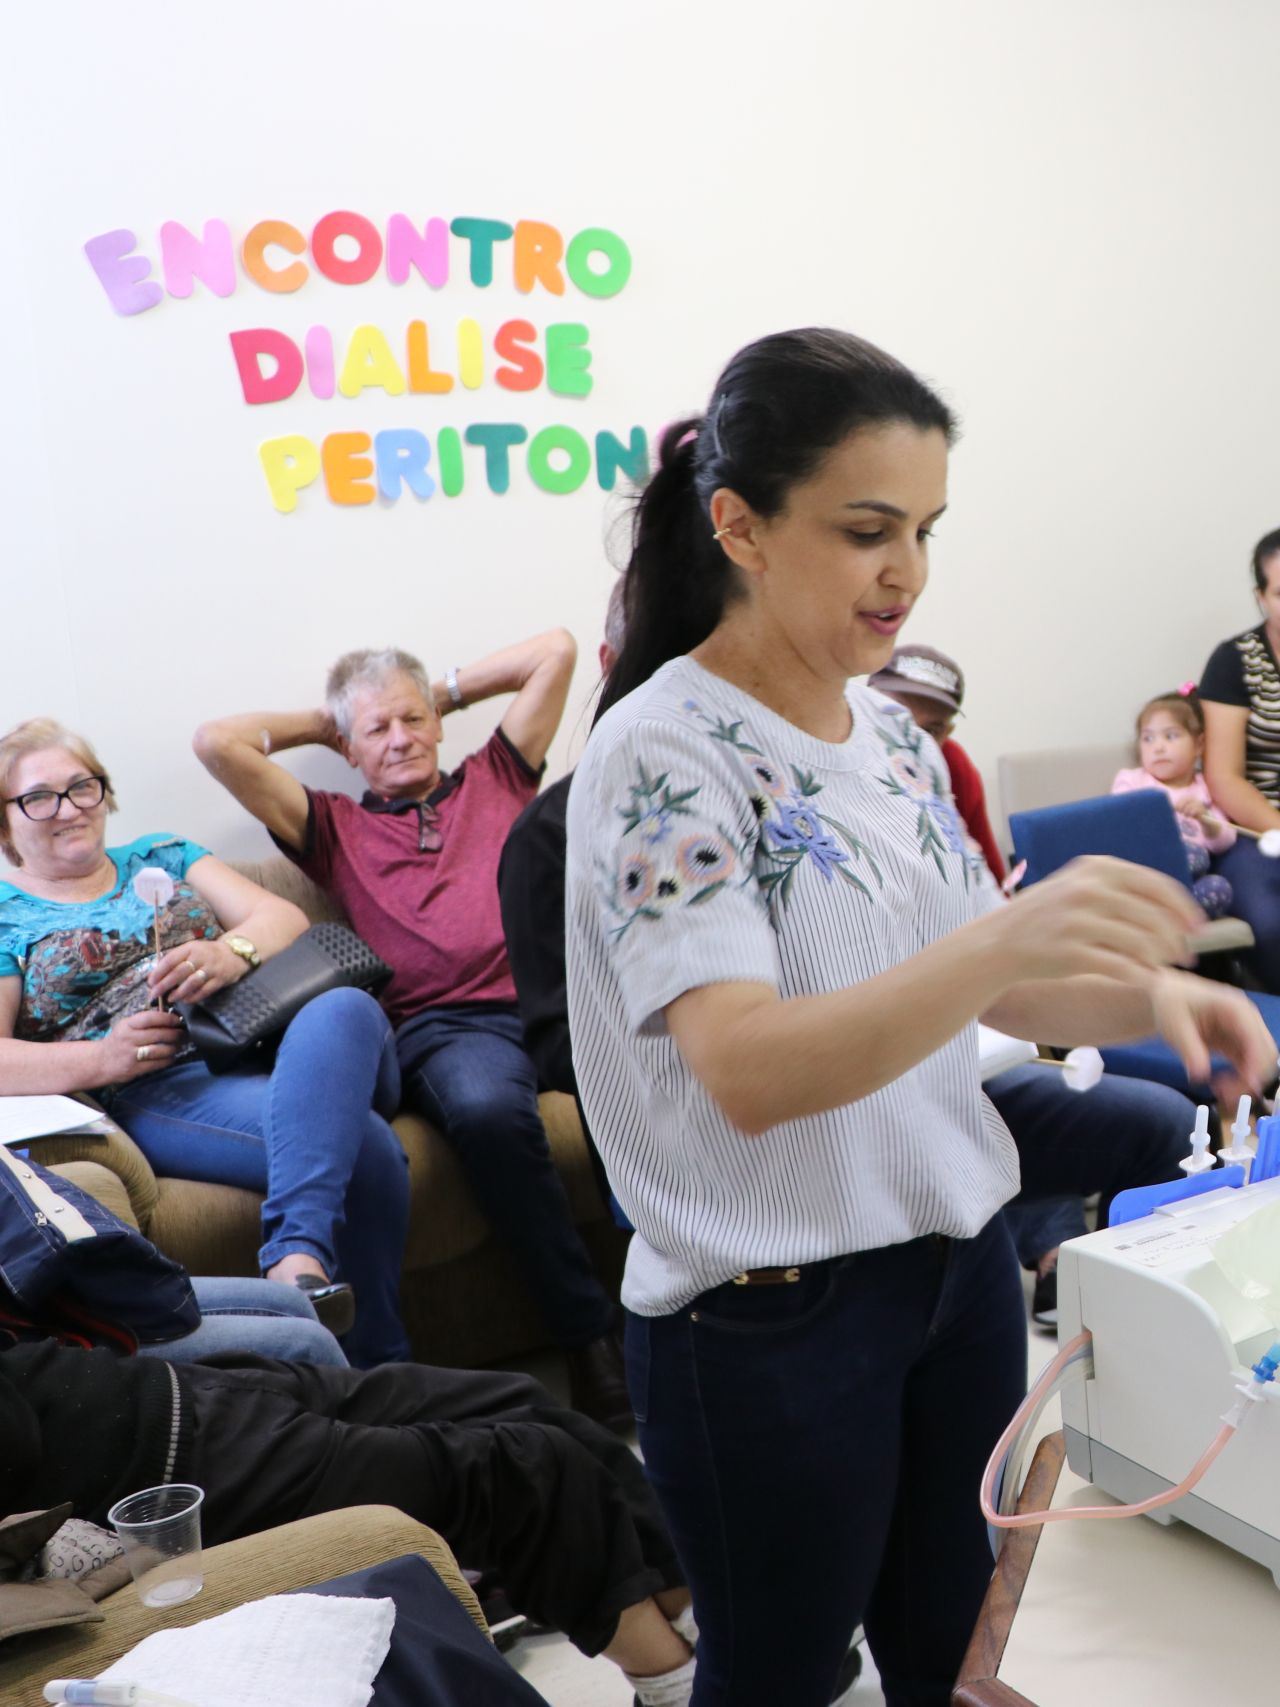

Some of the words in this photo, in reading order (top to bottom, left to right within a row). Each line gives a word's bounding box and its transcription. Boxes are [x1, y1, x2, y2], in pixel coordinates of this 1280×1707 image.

[84, 210, 632, 317] ENCONTRO
[229, 317, 595, 405] DIALISE
[258, 423, 650, 513] PERITON
